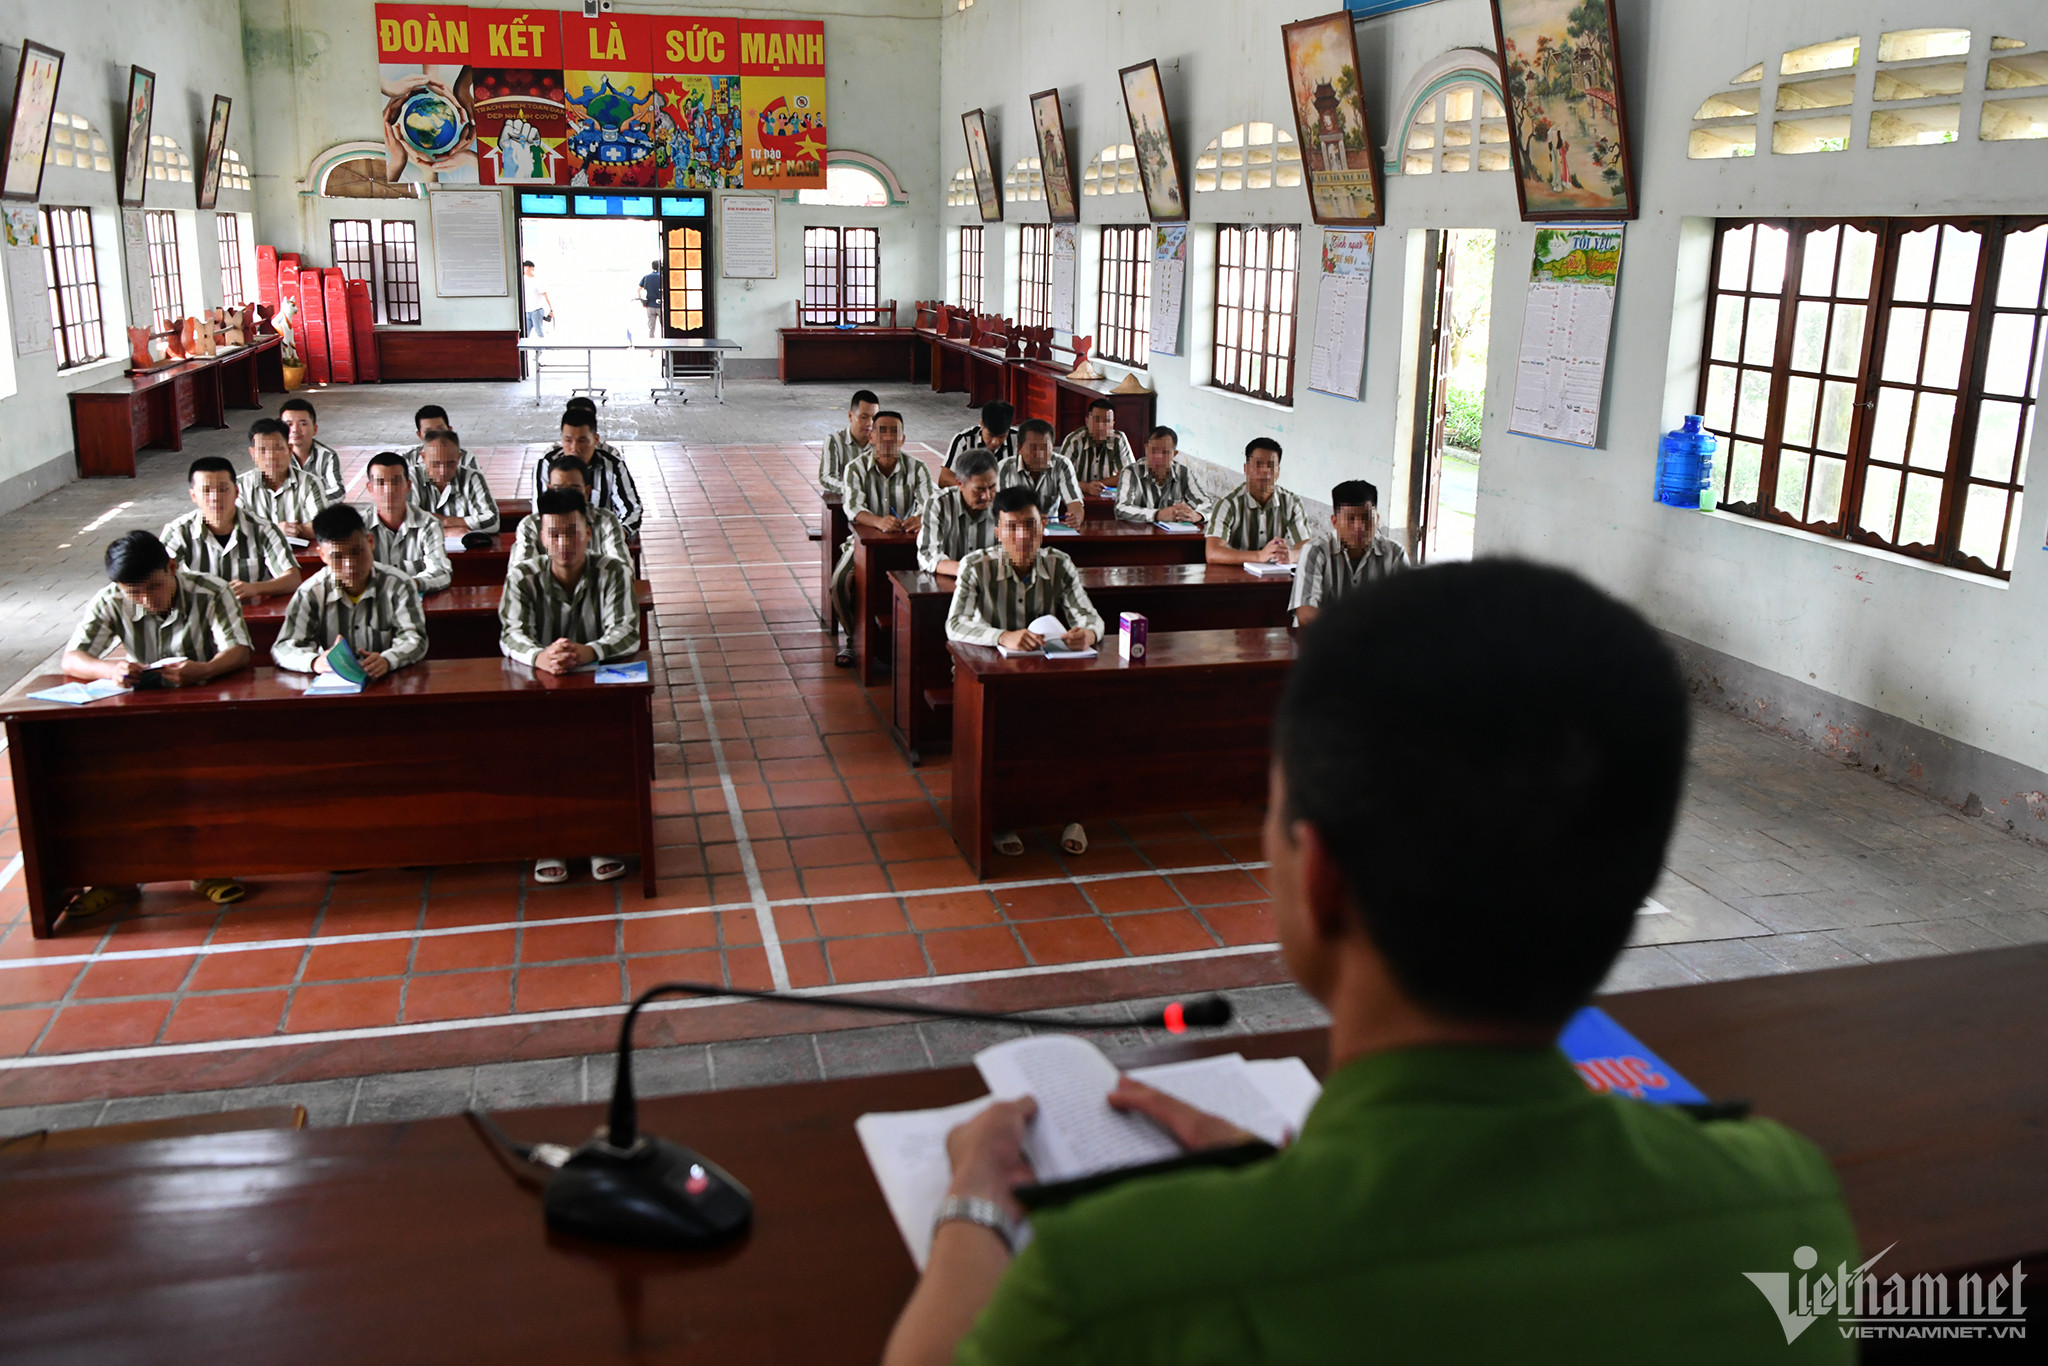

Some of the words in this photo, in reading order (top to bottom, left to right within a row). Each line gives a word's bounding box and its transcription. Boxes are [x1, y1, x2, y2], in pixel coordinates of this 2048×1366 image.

[380, 13, 469, 53] ĐOÀN
[488, 14, 545, 57] KẾT
[589, 21, 627, 60] LÀ
[666, 23, 725, 63] SỨC
[741, 32, 824, 71] MẠNH
[752, 157, 782, 180] VIỆT
[786, 159, 819, 177] NAM
